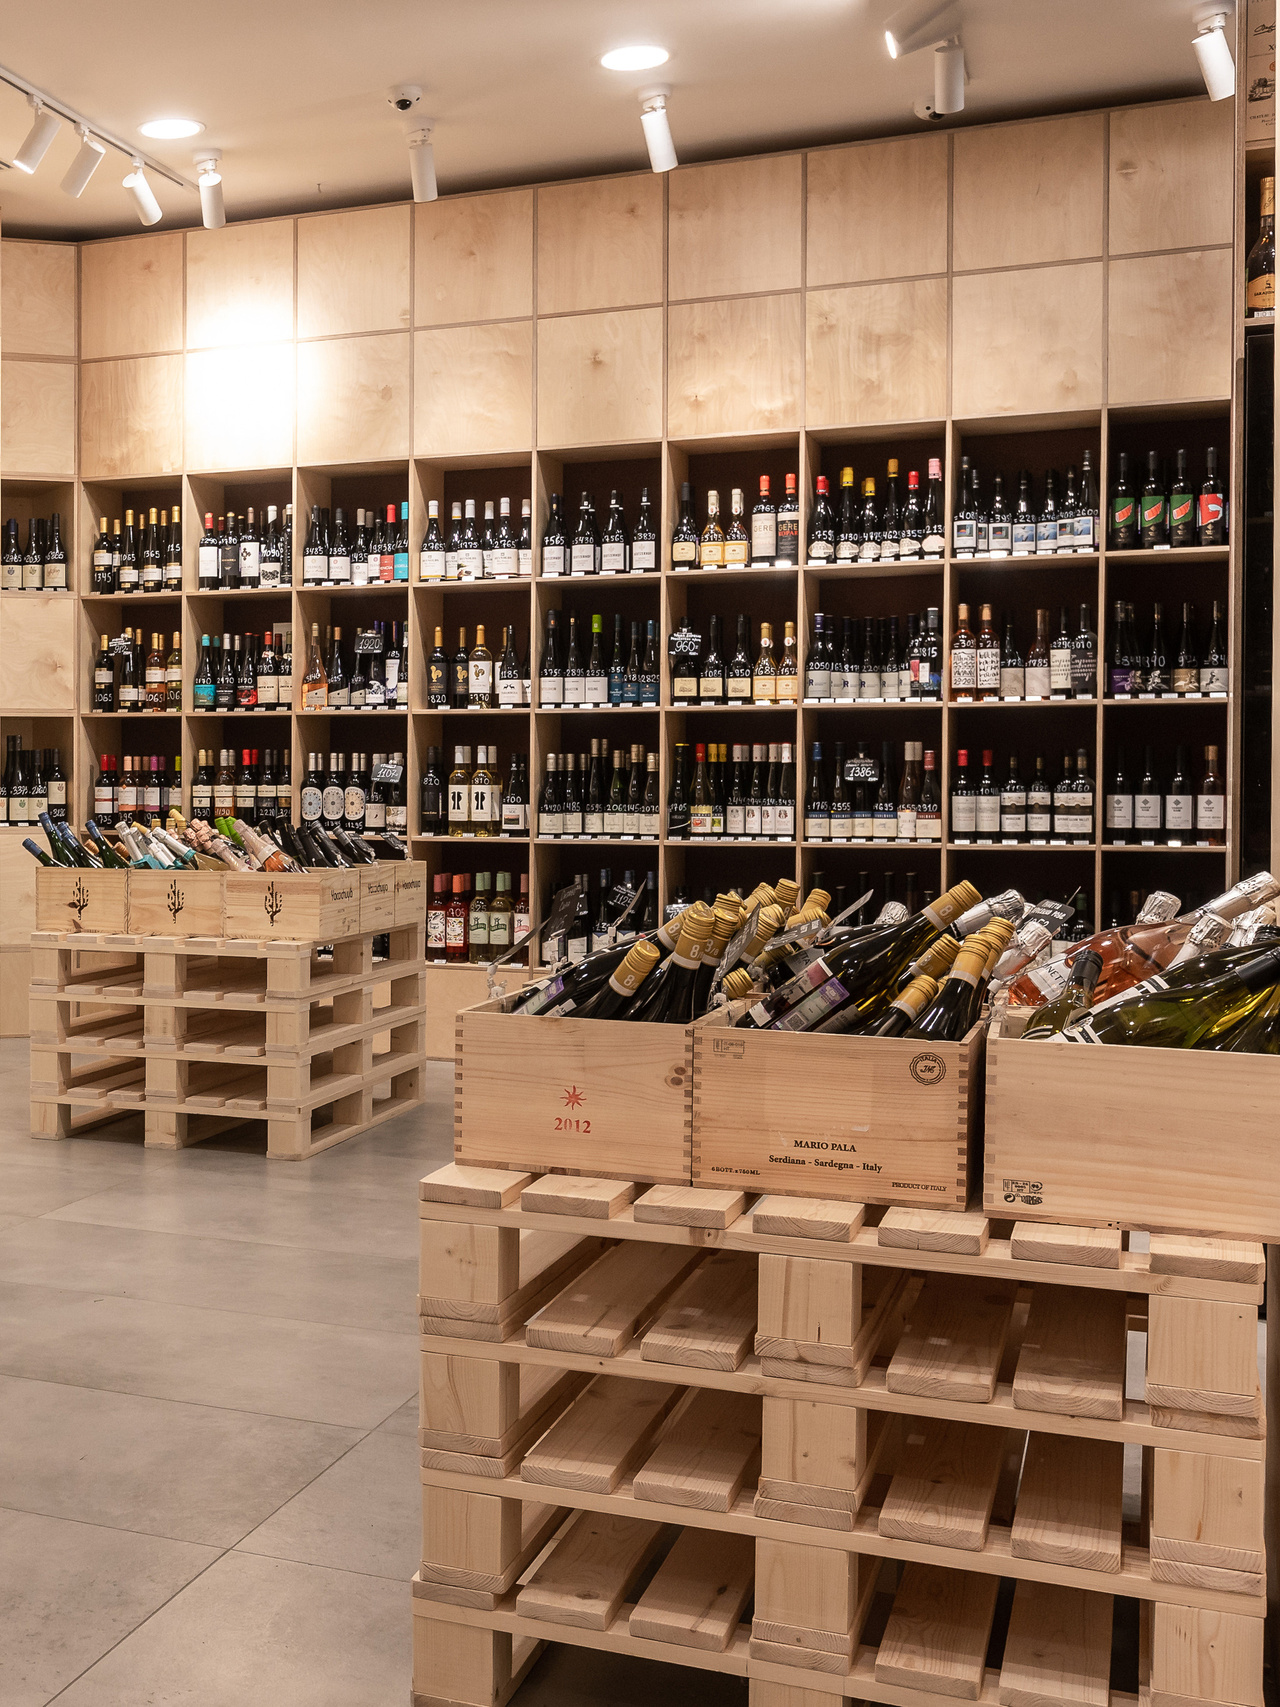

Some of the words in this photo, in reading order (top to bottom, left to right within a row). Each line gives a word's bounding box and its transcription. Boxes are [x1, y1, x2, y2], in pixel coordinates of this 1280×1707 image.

[778, 523, 798, 531] GERE
[919, 1055, 938, 1064] ITALIA
[553, 1116, 593, 1135] 2012
[793, 1139, 829, 1150] MARIO
[830, 1142, 857, 1152] PALA
[768, 1155, 806, 1166] Serdiana
[814, 1158, 854, 1171] Sardegna
[862, 1162, 883, 1174] Italy
[891, 1182, 921, 1190] PRODUCT
